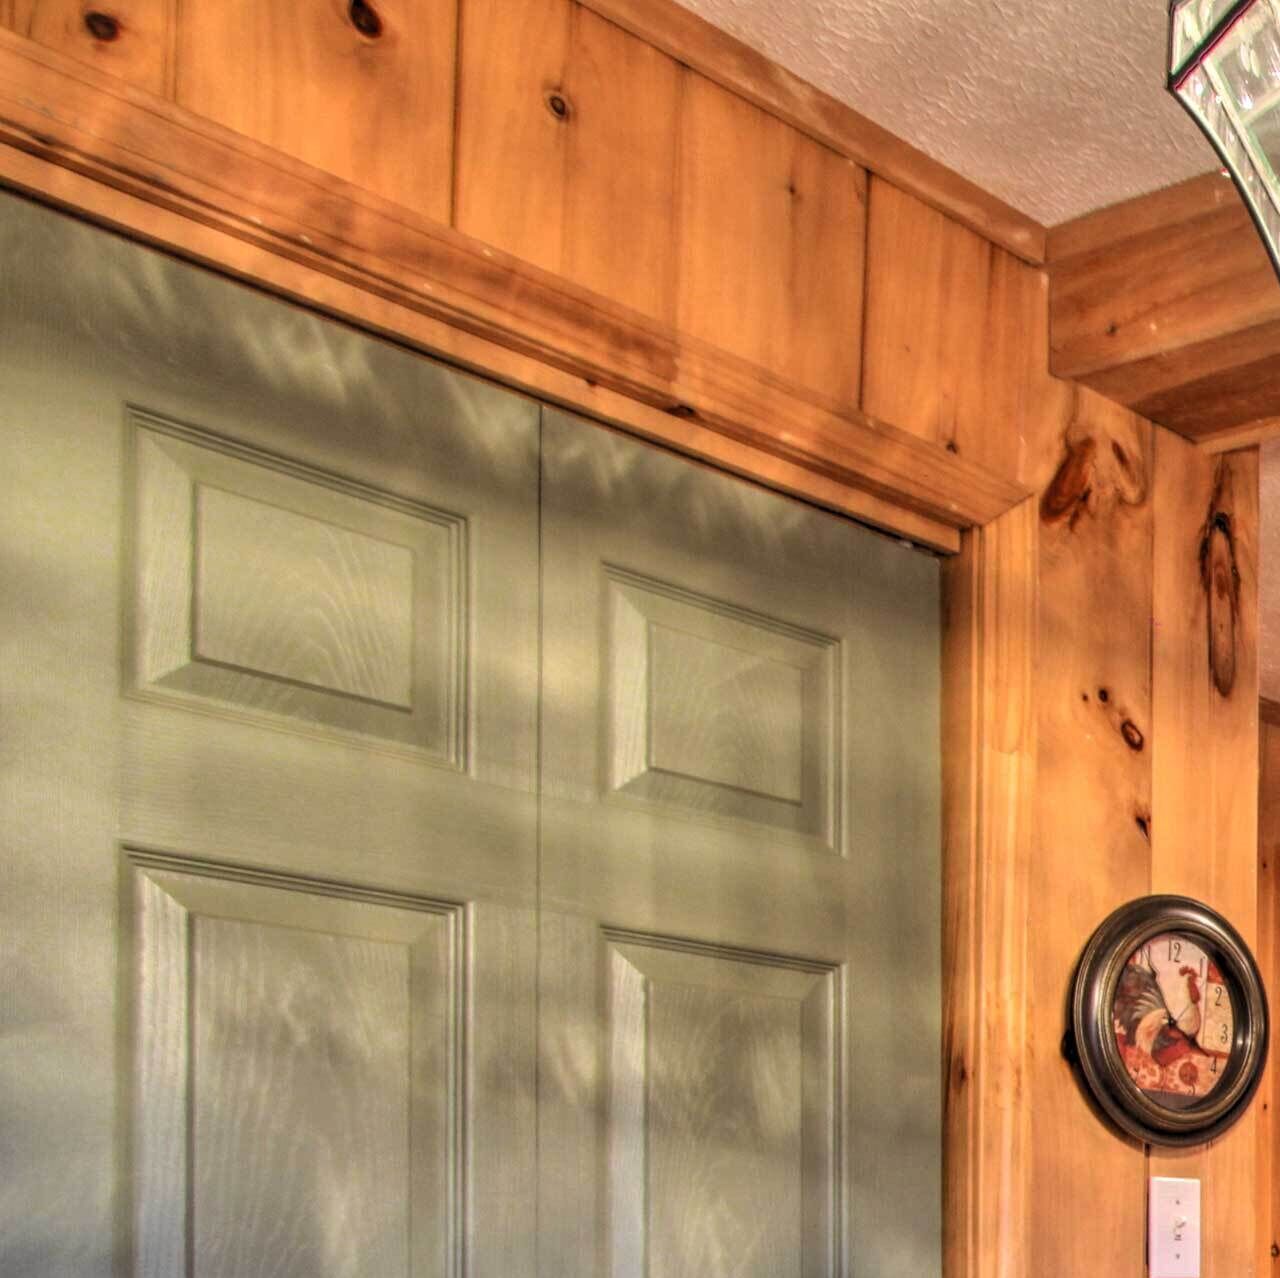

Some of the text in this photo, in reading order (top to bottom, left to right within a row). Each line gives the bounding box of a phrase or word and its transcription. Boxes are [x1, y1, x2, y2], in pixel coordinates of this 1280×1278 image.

[1168, 937, 1182, 963] 12
[1214, 986, 1222, 1007] 2
[1220, 1024, 1229, 1045] 3
[1209, 1055, 1217, 1074] 4
